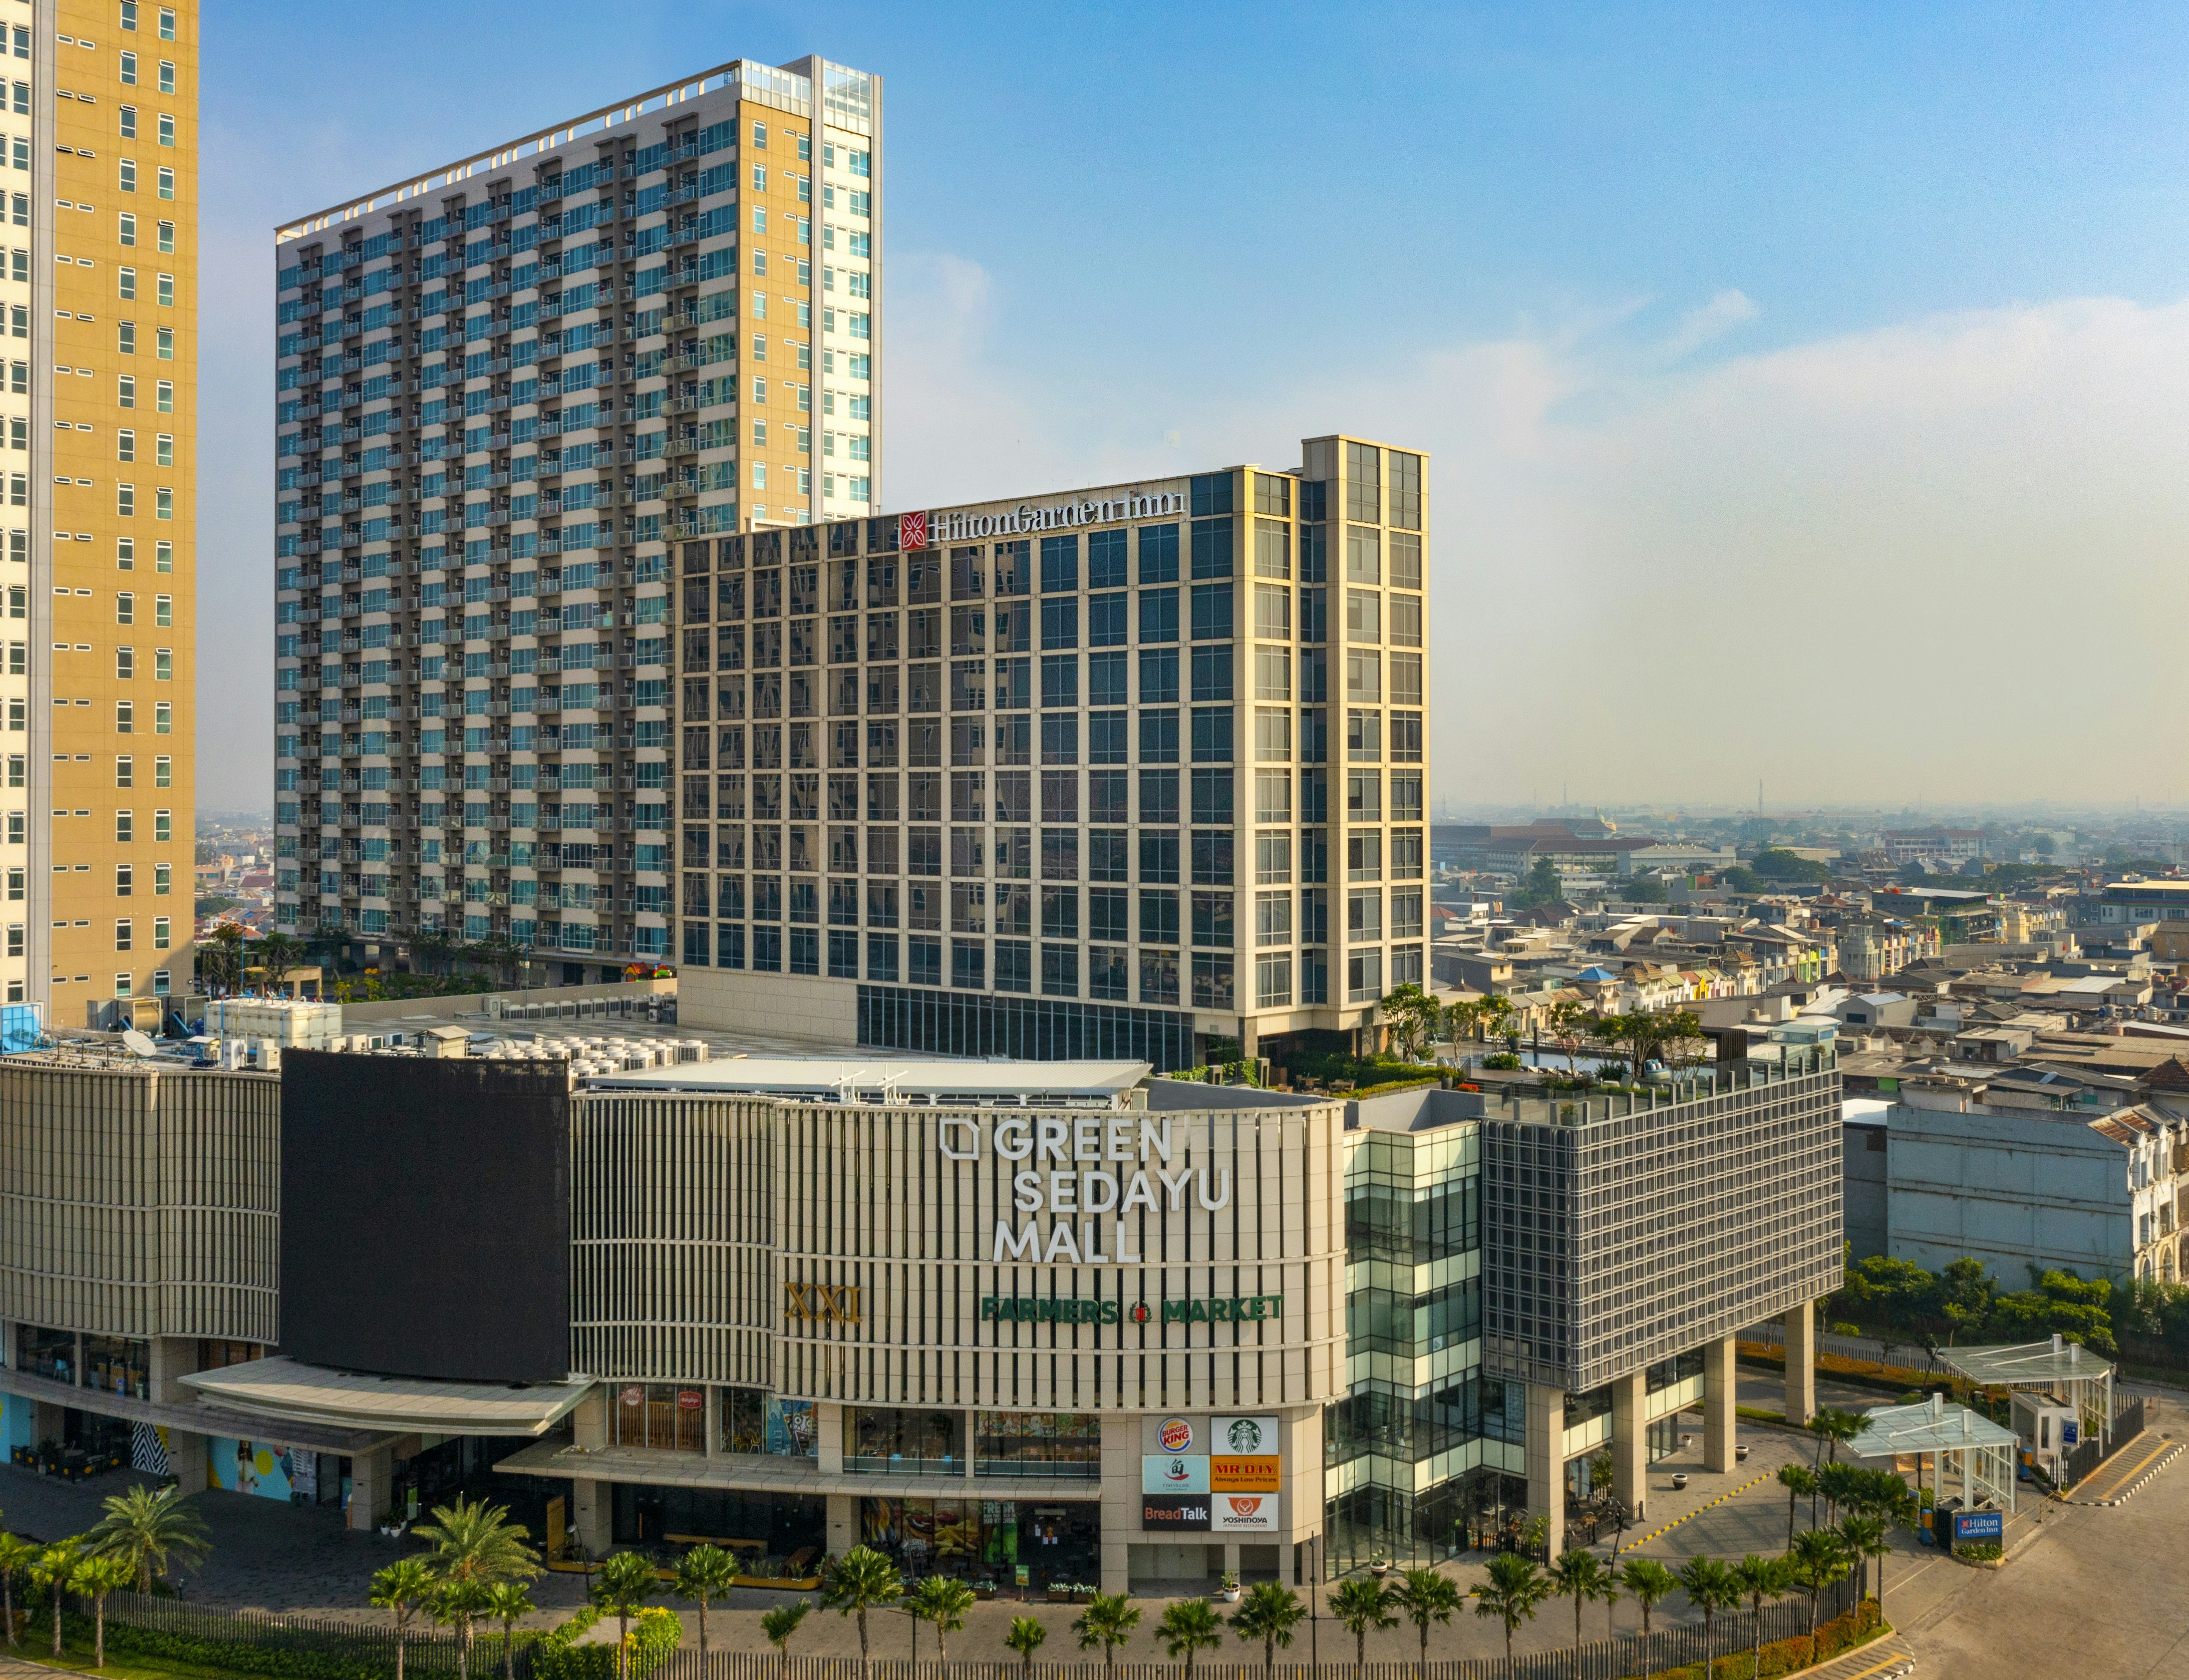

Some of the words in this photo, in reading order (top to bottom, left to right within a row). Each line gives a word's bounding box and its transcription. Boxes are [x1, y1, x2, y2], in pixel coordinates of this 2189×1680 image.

[933, 511, 1013, 542] Hilton
[1014, 495, 1115, 533] Garden
[1122, 490, 1173, 519] Inn
[994, 1118, 1172, 1161] GREEN
[1014, 1169, 1230, 1213] SEDAYU
[993, 1220, 1141, 1263] MALL
[783, 1282, 862, 1323] XXI
[982, 1296, 1118, 1324] FARMERS
[1163, 1294, 1285, 1324] MARKET
[1162, 1425, 1188, 1437] BURGER
[1163, 1431, 1189, 1445] KING
[1145, 1507, 1207, 1520] BreadTalk
[1969, 1518, 1998, 1528] Hilton
